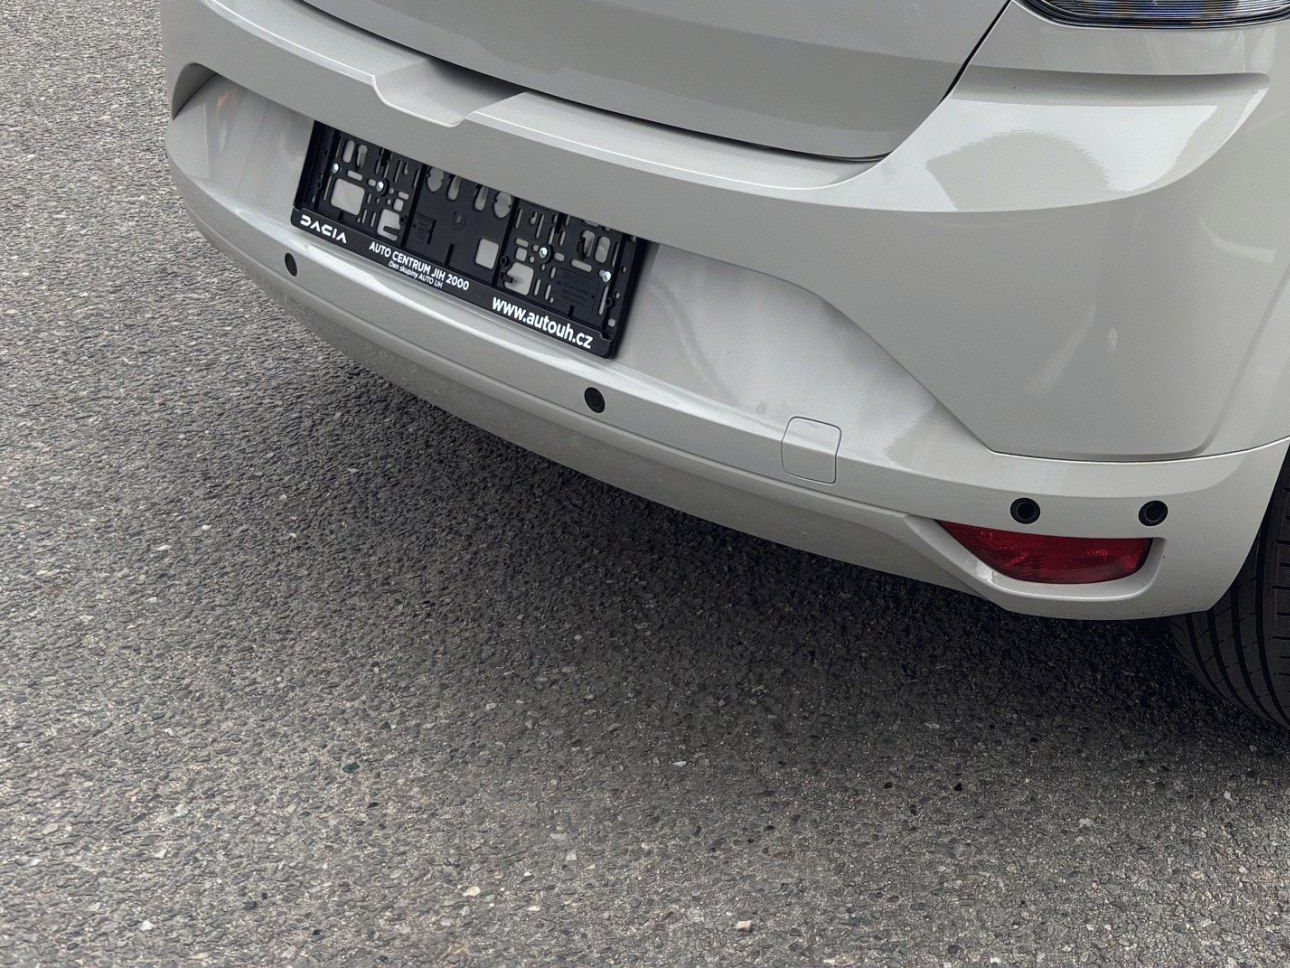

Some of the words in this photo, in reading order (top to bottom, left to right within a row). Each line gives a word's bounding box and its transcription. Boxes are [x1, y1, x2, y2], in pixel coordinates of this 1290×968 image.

[300, 215, 347, 244] DACIA
[369, 242, 391, 259] AUTO
[392, 249, 431, 275] CENTRUM
[432, 268, 446, 282] JIH
[446, 273, 470, 292] 2000
[419, 271, 434, 286] AUTO
[491, 296, 594, 350] www.autouh.cz
